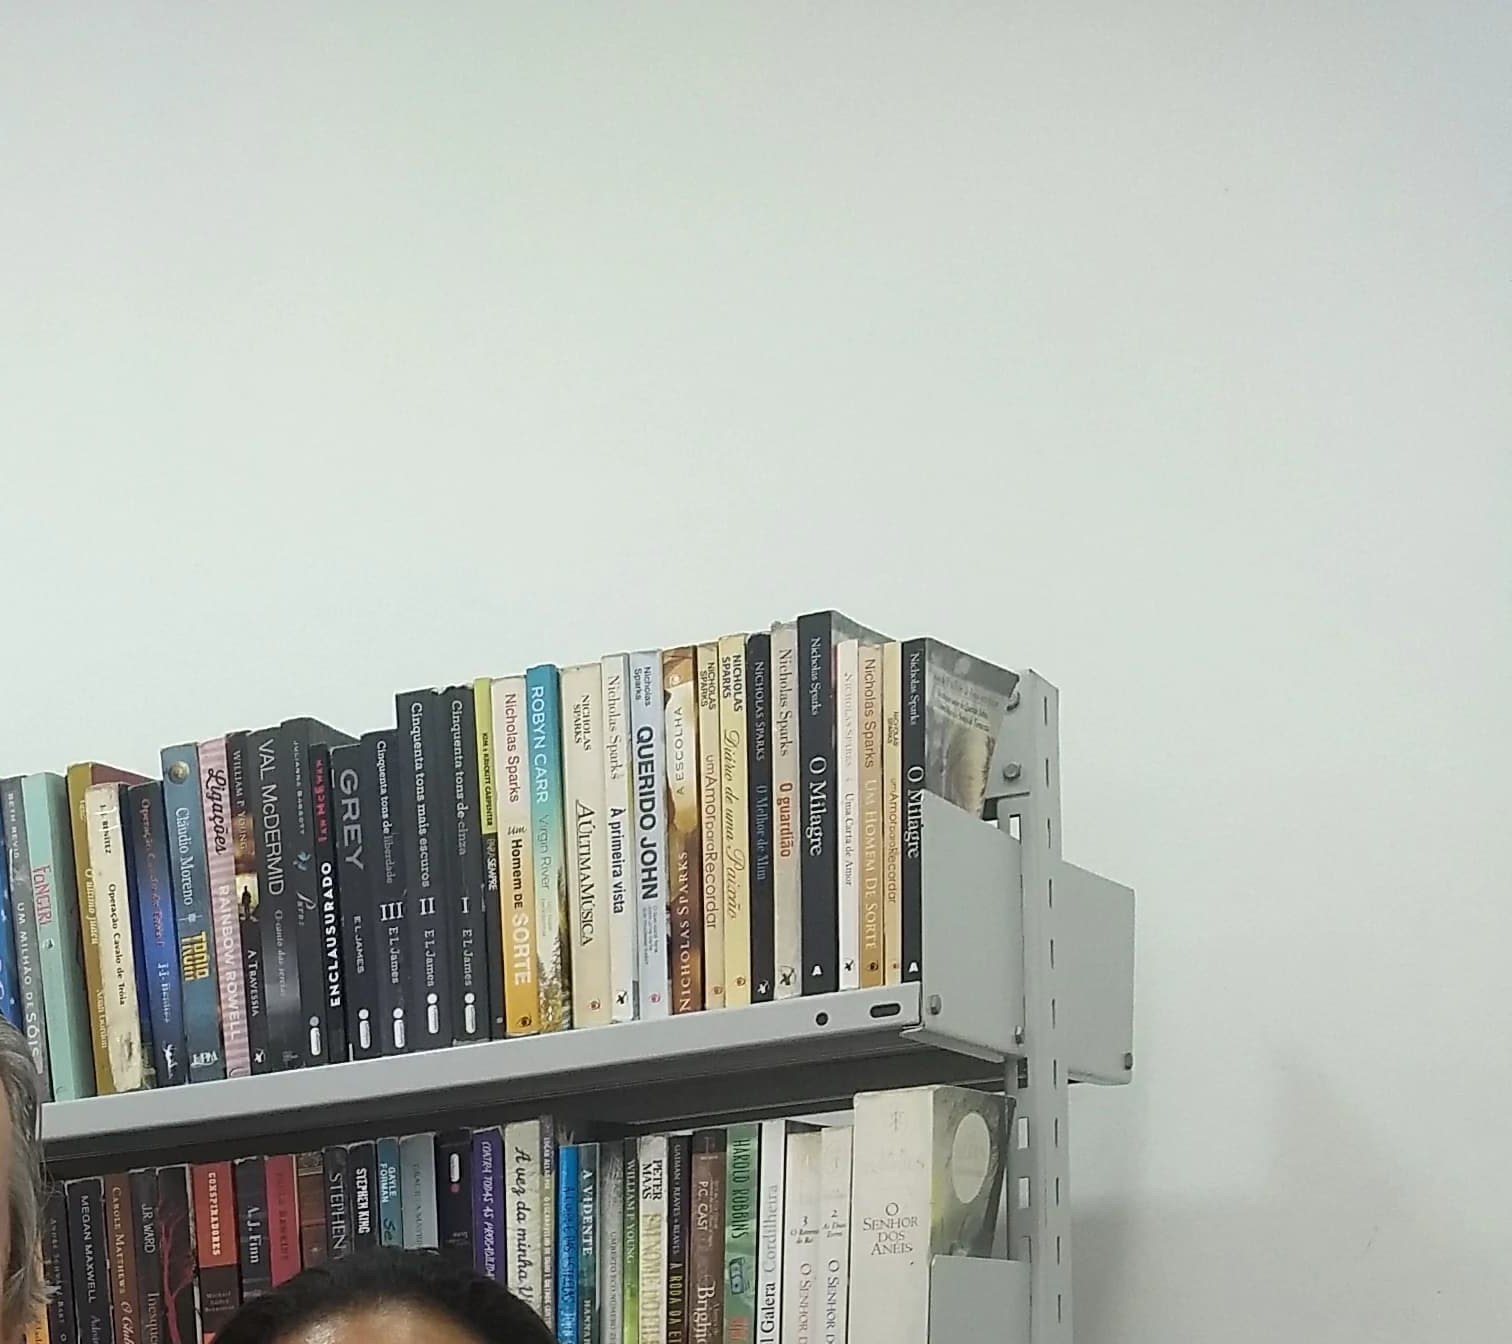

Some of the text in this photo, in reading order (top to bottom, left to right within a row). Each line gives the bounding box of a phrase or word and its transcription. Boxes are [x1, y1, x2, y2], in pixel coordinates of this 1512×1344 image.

[721, 656, 731, 699] SPARKS
[730, 653, 743, 712] NICHOLAS
[754, 661, 766, 761] NICHOLAS SPARKS
[810, 637, 822, 717] Nicholas Sparks
[504, 693, 520, 803] Nicholas Sparks
[531, 686, 550, 804] ROBYN CARR
[636, 725, 658, 831] QUERIDO
[674, 707, 685, 796] A ESCOLHA
[207, 768, 229, 855] Ligações
[257, 739, 285, 896] VAL McDERMID
[339, 768, 364, 872] GREY
[777, 782, 793, 857] O guardião
[808, 756, 826, 857] O Milagre
[175, 807, 194, 906] Cláudio Moreno
[610, 822, 625, 881] primeira
[640, 834, 659, 901] JOHN
[864, 779, 876, 951] UM HOMEM DE SORTE
[320, 862, 341, 1008] ENCLAUSURADO
[612, 884, 625, 914] vista
[677, 852, 692, 1012] NICHOLAS SPARKS
[219, 884, 243, 1041] RAINBOW ROWELL
[356, 1167, 370, 1235] STEPHEN KING
[380, 1163, 389, 1204] FORMAN
[387, 1167, 396, 1197] GAYLE
[512, 1146, 533, 1289] A vez da minha
[582, 1170, 593, 1257] A VIDENTE
[642, 1163, 652, 1200] MAAS
[652, 1159, 663, 1200] PETER
[731, 1140, 749, 1239] HAROLD ROBBINS
[885, 1202, 899, 1217] O
[81, 1196, 97, 1304] MEGAN MAXWELL
[862, 1216, 919, 1231] SENHOR
[870, 1240, 913, 1256] ANÉIS
[878, 1229, 905, 1242] DOS
[669, 1275, 683, 1304] RODA
[670, 1263, 676, 1271] A
[669, 1310, 683, 1324] DA
[761, 1282, 776, 1332] Galera
